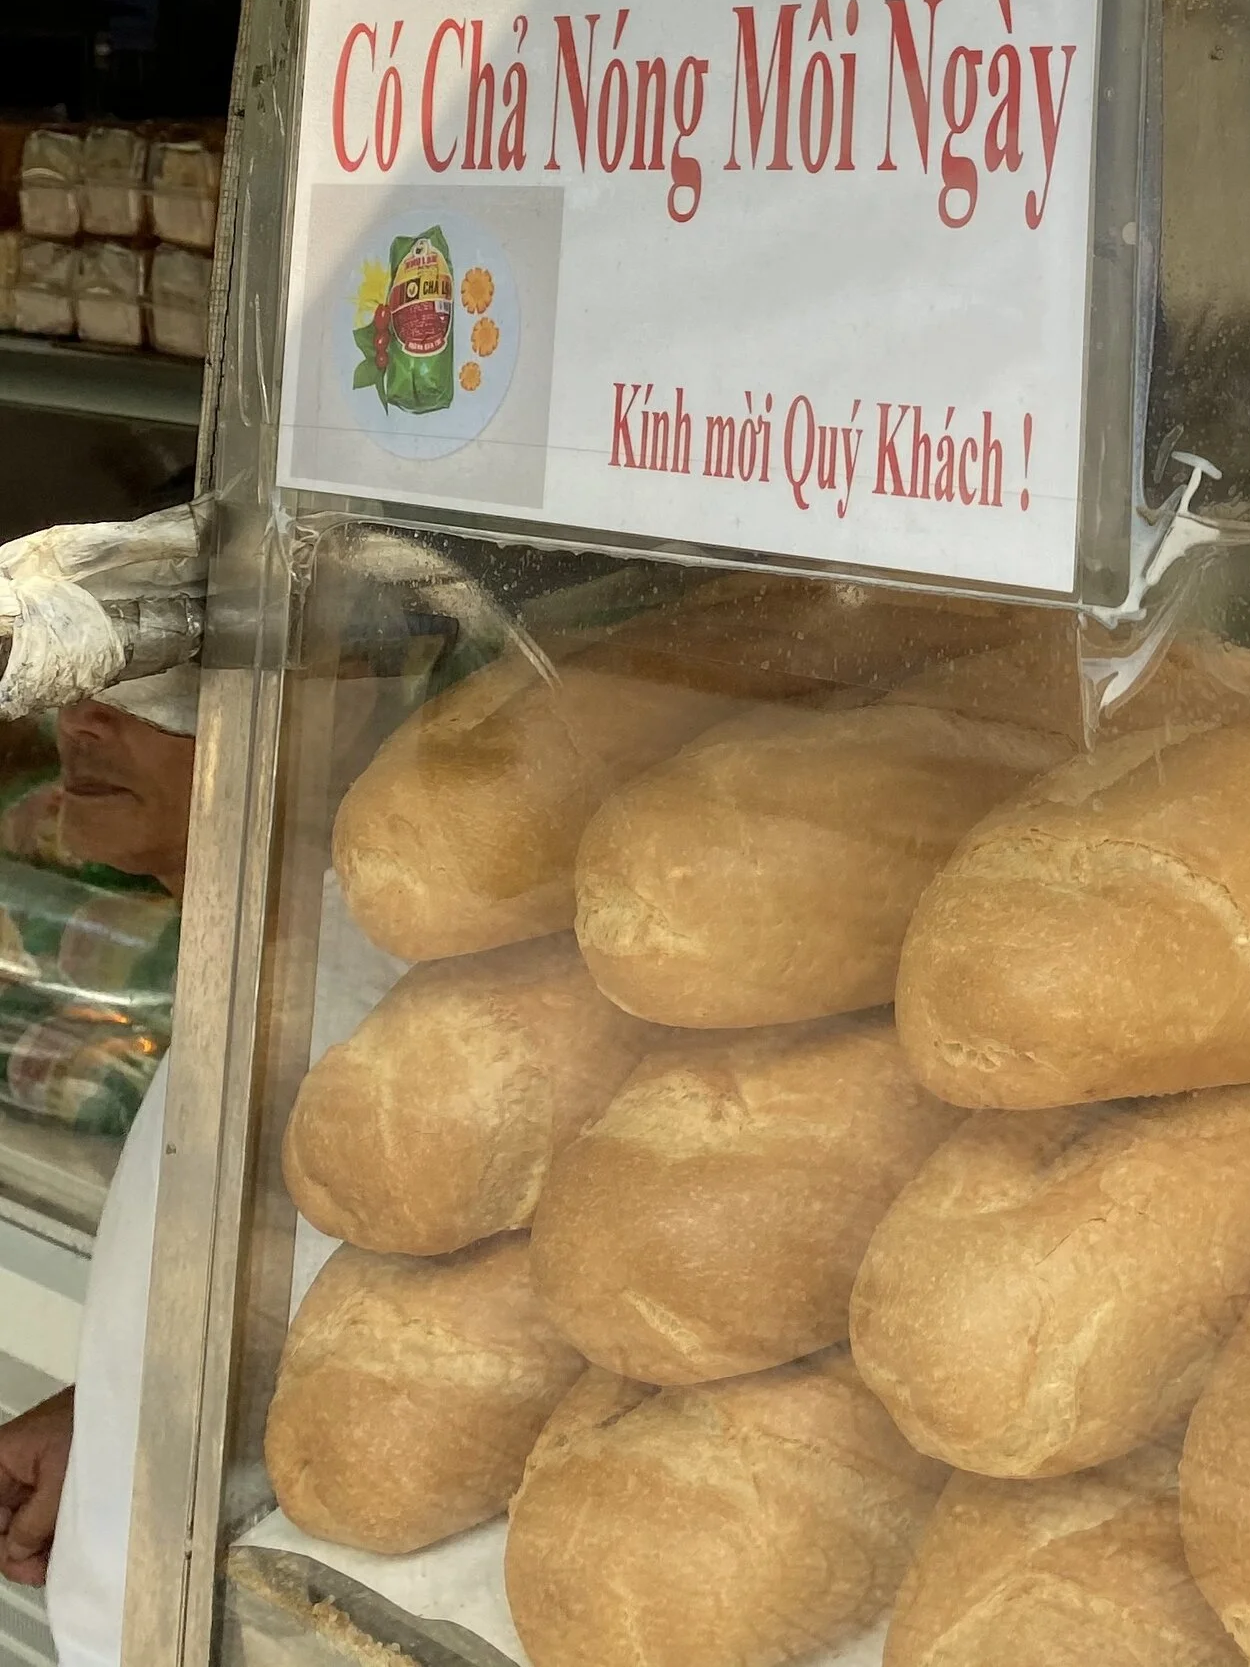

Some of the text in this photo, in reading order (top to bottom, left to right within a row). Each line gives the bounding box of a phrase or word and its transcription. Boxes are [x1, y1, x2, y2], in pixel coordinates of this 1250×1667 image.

[332, 19, 404, 174] Có
[420, 14, 528, 172] Chả
[545, 8, 709, 223] Nóng
[608, 382, 1034, 518] Kính mời Quý Khách !
